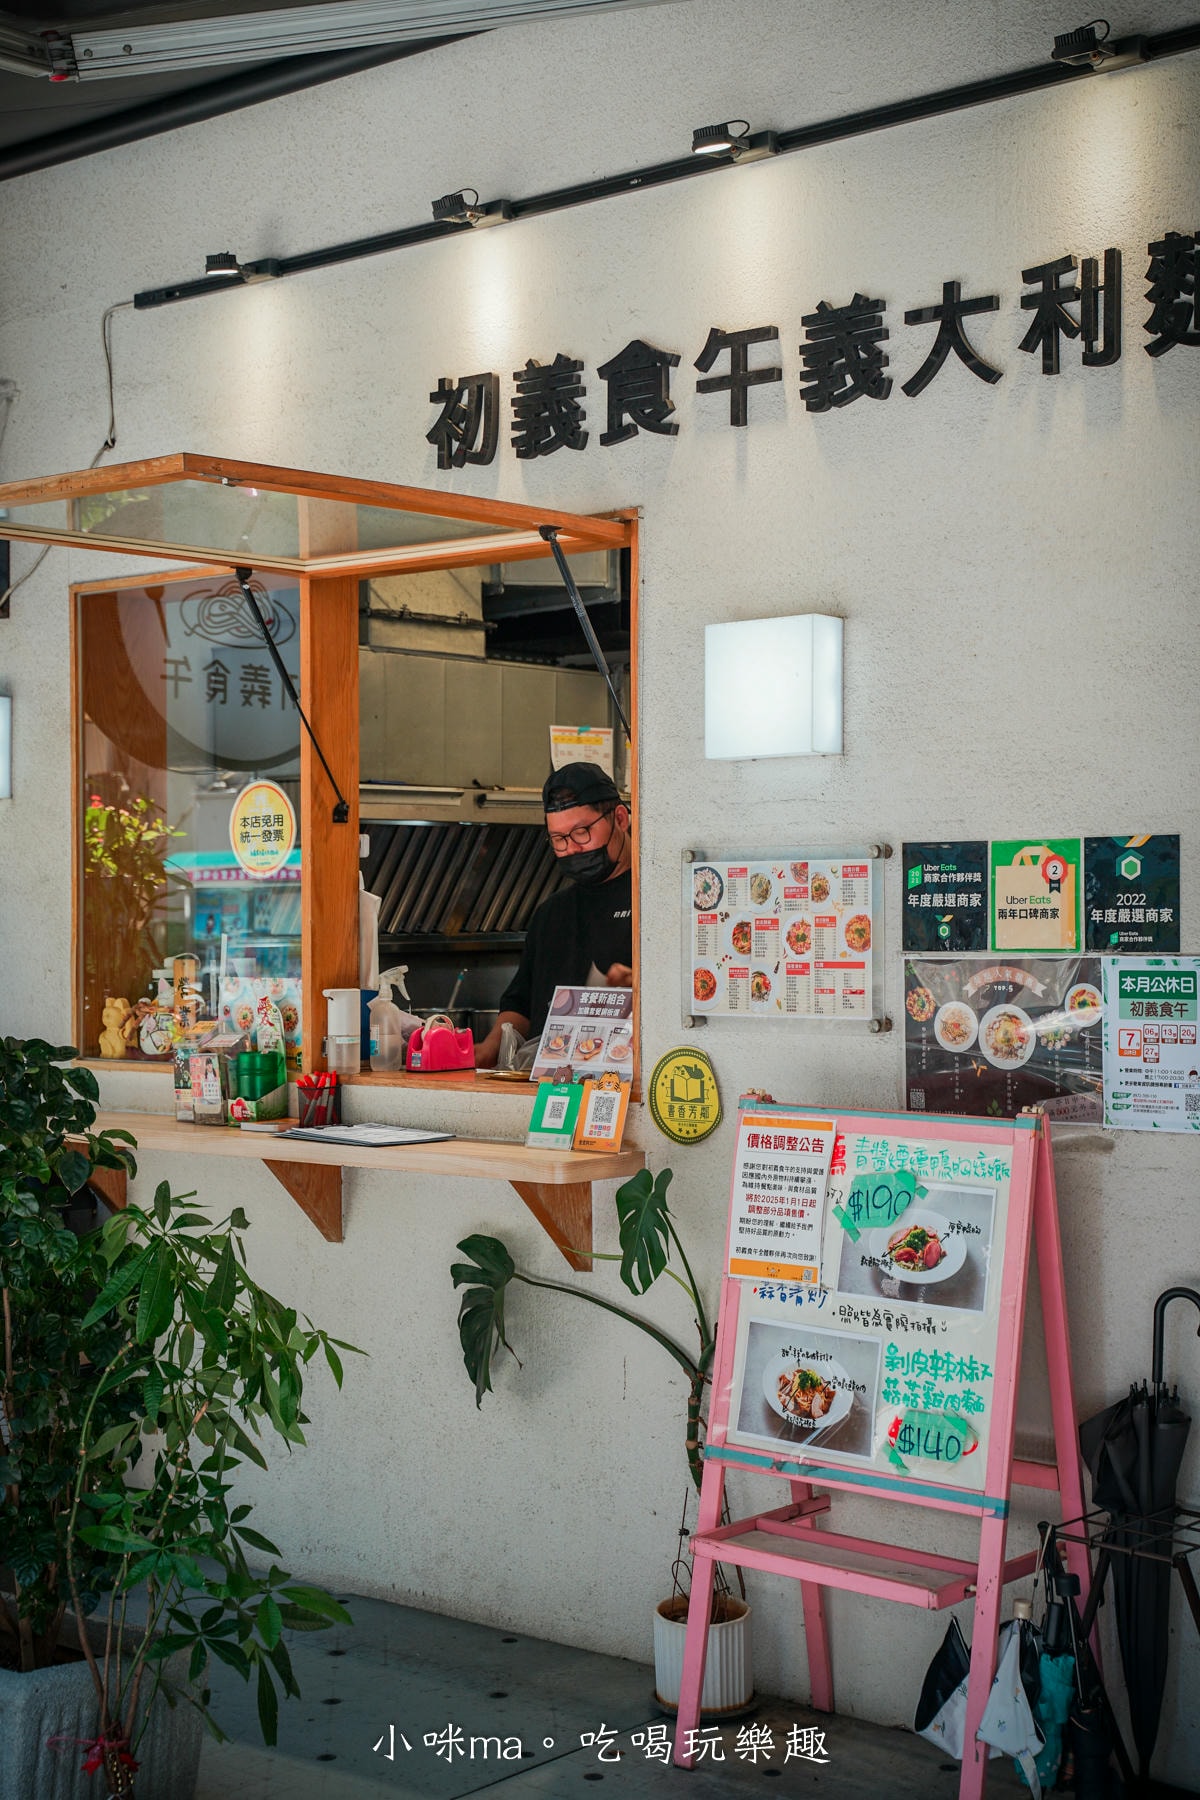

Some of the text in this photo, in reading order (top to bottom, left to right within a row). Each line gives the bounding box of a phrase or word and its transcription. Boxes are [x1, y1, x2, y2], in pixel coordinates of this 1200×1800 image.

[240, 814, 284, 829] 本店免用
[240, 829, 284, 843] 統一發票
[923, 864, 957, 872] Uber Eats
[1052, 865, 1058, 875] 2
[924, 873, 982, 883] 商家合作夥伴獎
[907, 893, 982, 908] 年度嚴選商家
[1006, 896, 1051, 905] Uber Eats
[1116, 893, 1146, 906] 2022
[998, 908, 1060, 920] 兩年口碑商家
[1090, 908, 1174, 923] 年度嚴選商家
[1121, 976, 1194, 994] 本月公休日
[579, 991, 628, 1005] 套餐新組合
[1130, 1001, 1189, 1018] 初義食午
[667, 1104, 711, 1119] 書香芳鄰
[747, 1132, 825, 1154] 價格調整公告
[745, 1193, 817, 1208] 將於2025年1月1日起
[849, 1184, 912, 1223] $190
[897, 1423, 961, 1462] $140
